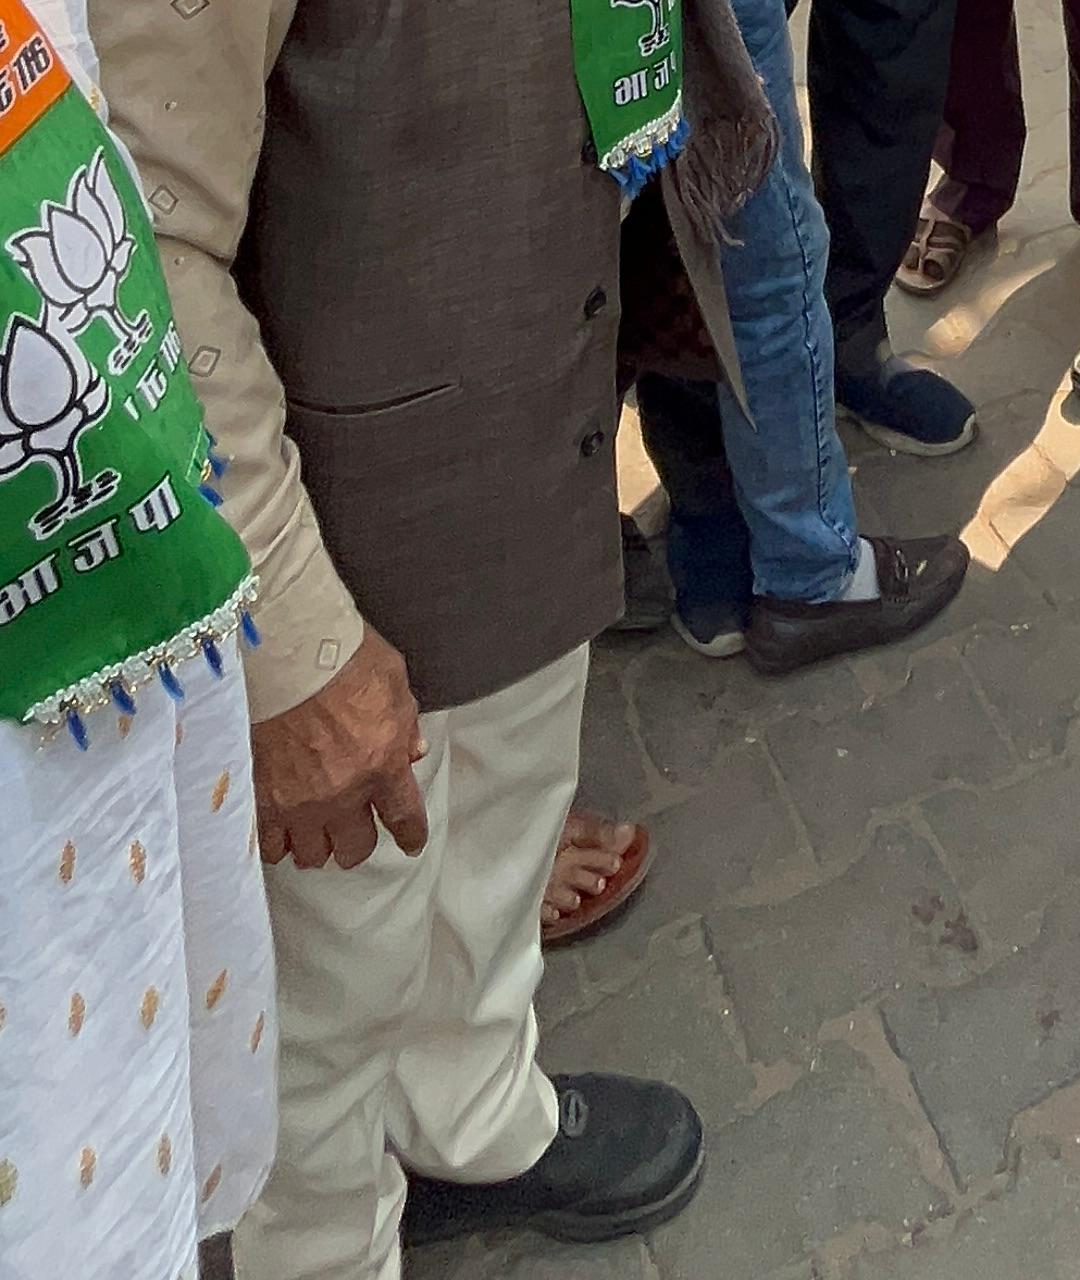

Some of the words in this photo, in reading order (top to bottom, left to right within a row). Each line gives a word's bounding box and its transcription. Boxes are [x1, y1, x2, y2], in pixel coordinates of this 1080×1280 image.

[614, 68, 649, 105] भा
[67, 517, 120, 572] ज
[127, 474, 182, 532] पा
